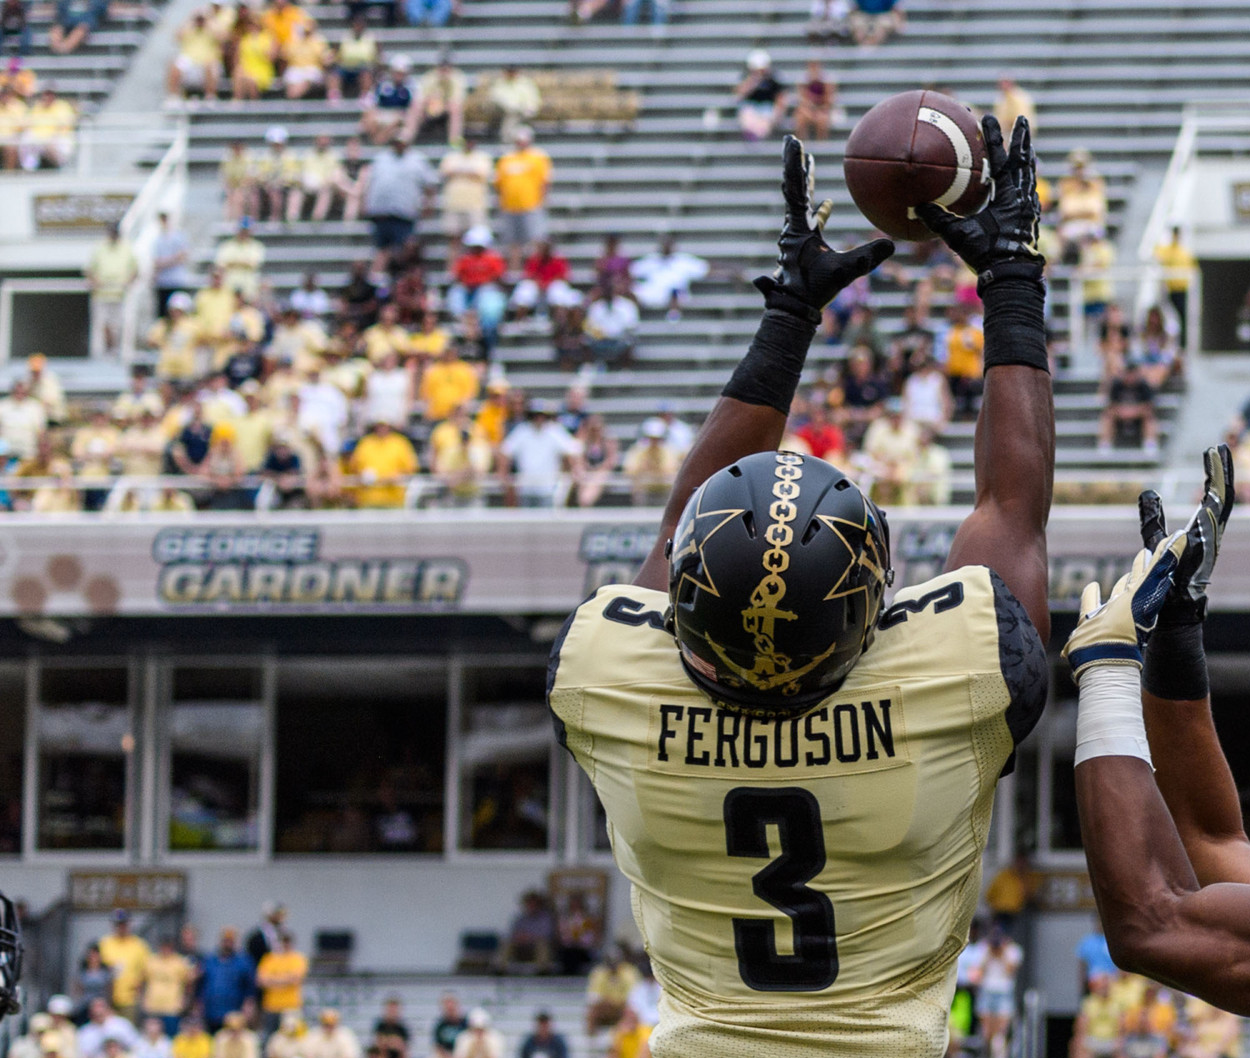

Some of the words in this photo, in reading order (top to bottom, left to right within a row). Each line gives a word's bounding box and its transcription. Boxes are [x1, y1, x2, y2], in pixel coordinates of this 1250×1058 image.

[153, 528, 321, 562] GEORGE
[158, 560, 467, 604] GARDNER
[657, 699, 896, 768] FERGUSON
[723, 786, 840, 992] 3
